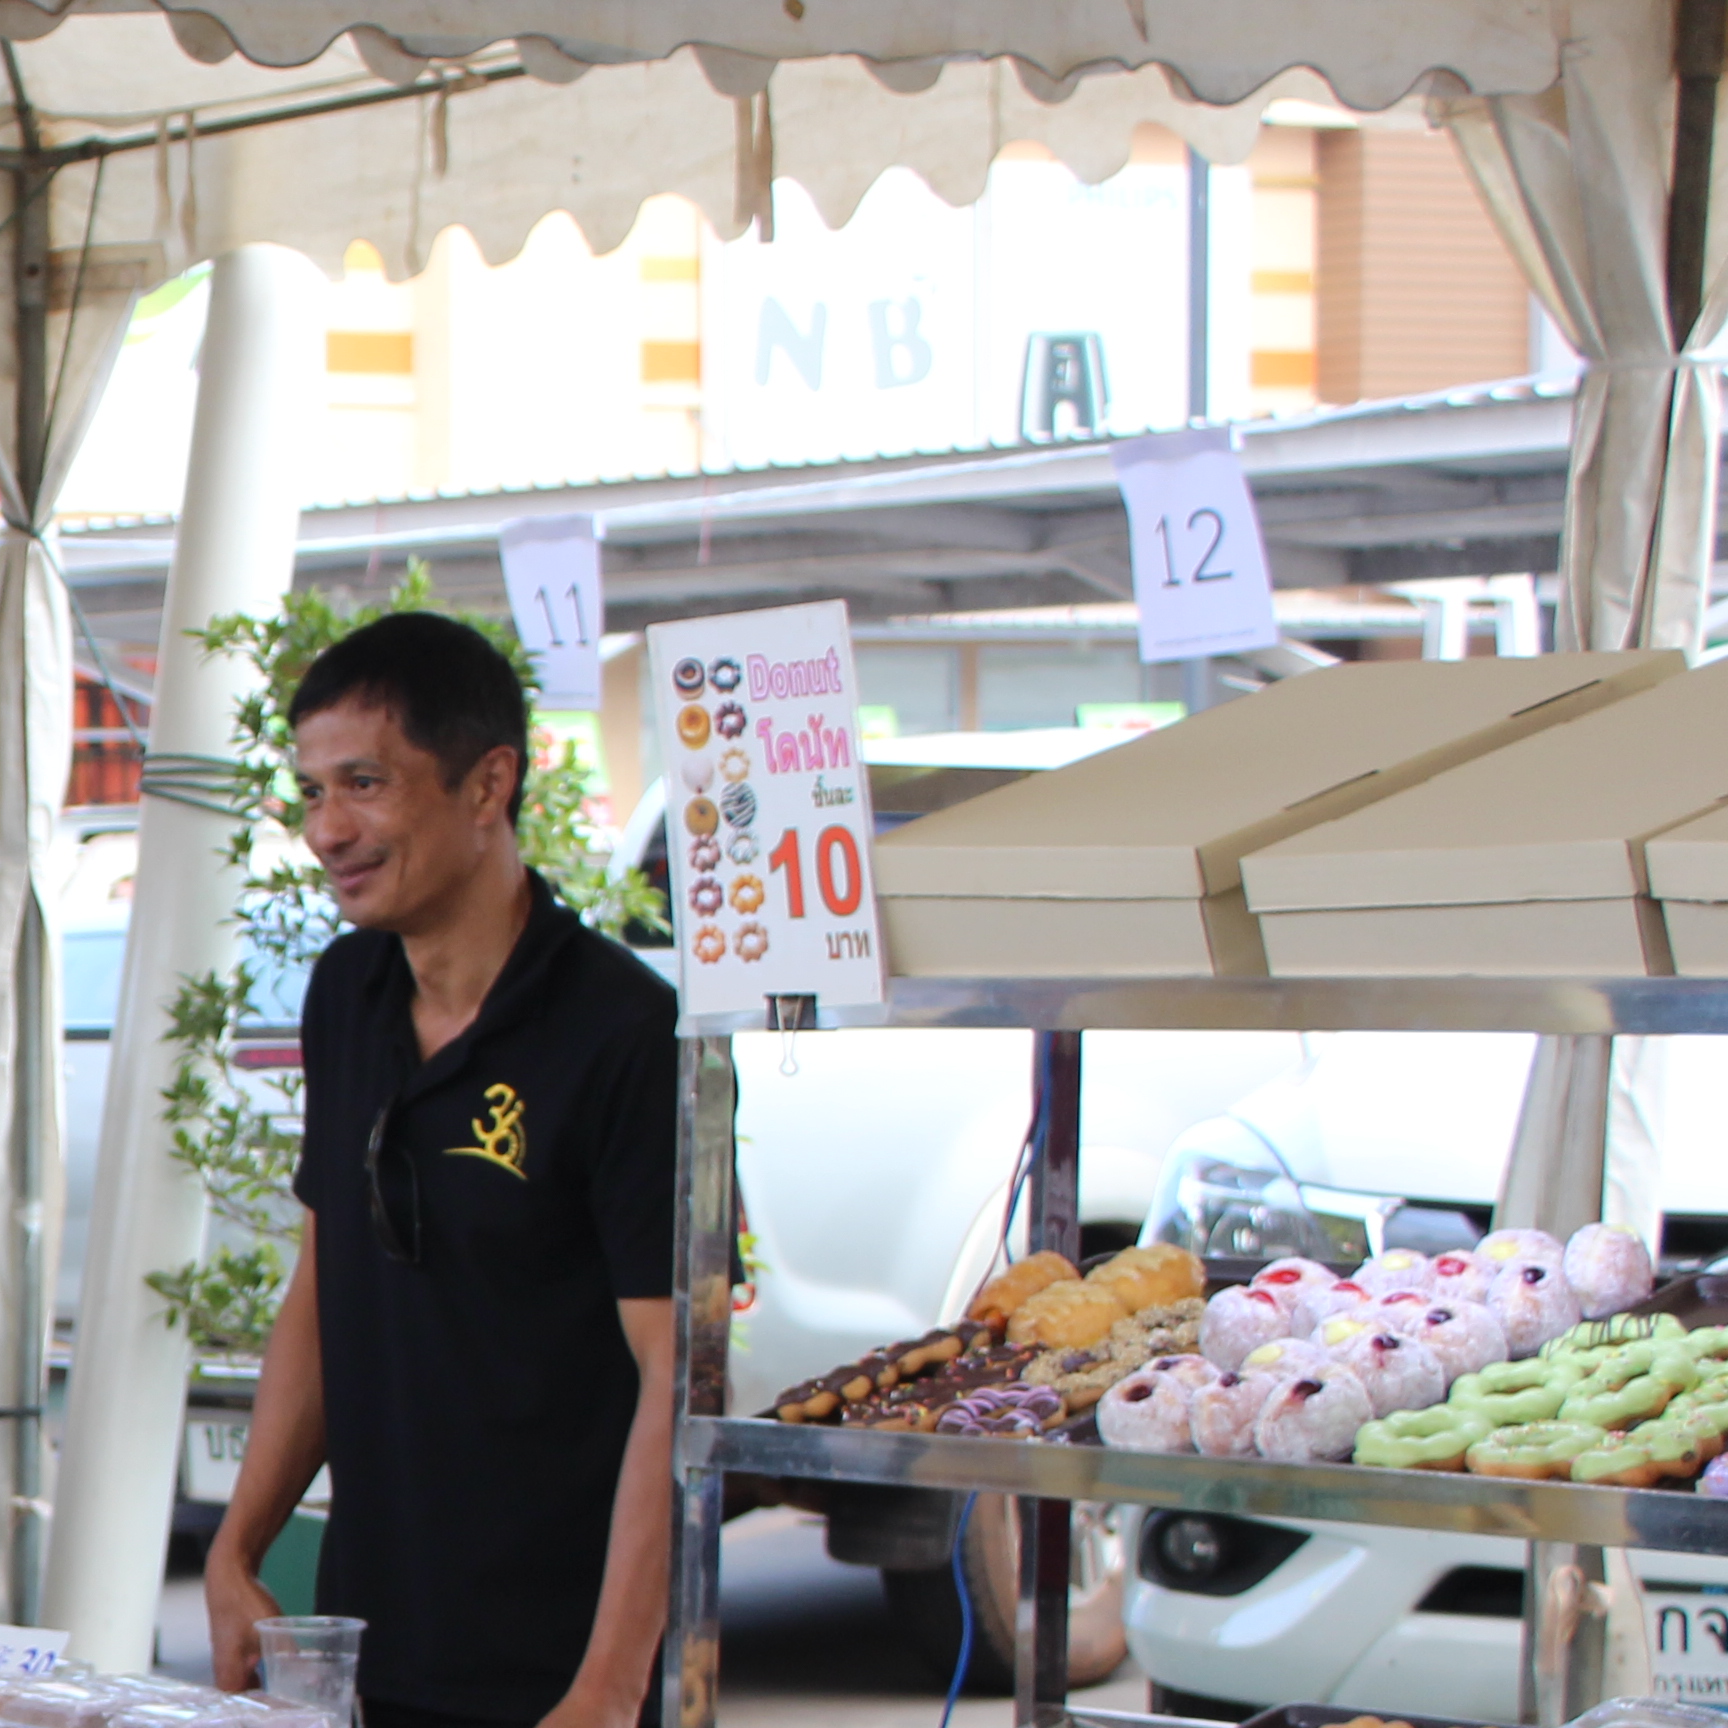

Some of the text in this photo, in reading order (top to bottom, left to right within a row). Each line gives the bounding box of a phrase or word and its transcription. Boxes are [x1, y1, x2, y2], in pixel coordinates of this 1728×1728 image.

[1154, 506, 1234, 589] 12
[533, 580, 589, 647] 11
[746, 646, 842, 702] Donut
[755, 713, 851, 775] โดนัท
[768, 823, 864, 919] 10
[824, 928, 872, 961] บาท
